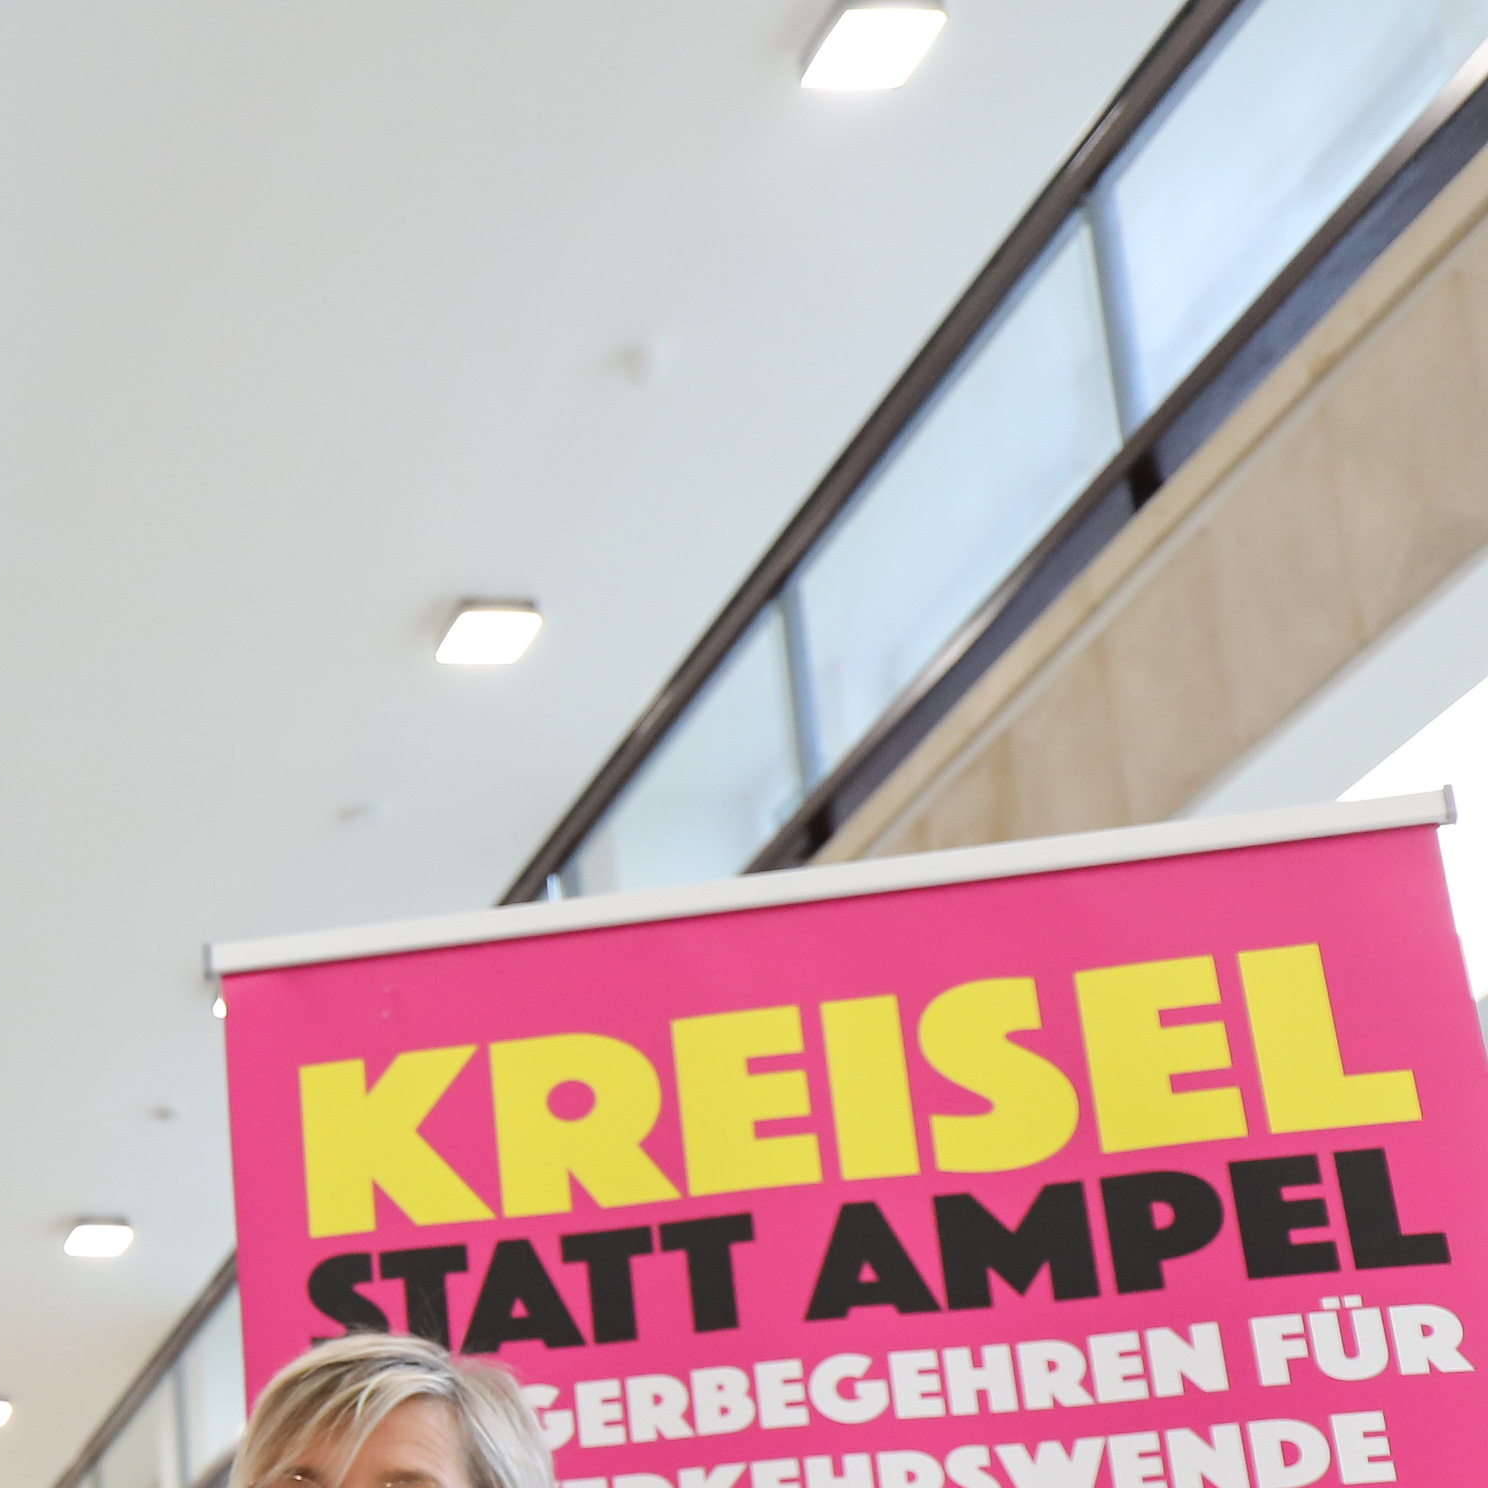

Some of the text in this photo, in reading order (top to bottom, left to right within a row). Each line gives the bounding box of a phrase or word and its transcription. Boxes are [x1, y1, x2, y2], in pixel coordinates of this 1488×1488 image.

[297, 941, 1422, 1239] KREISEL
[307, 1147, 1452, 1355] STATT AMPEL
[520, 1294, 1475, 1452] GERBEGEHREN FÜR
